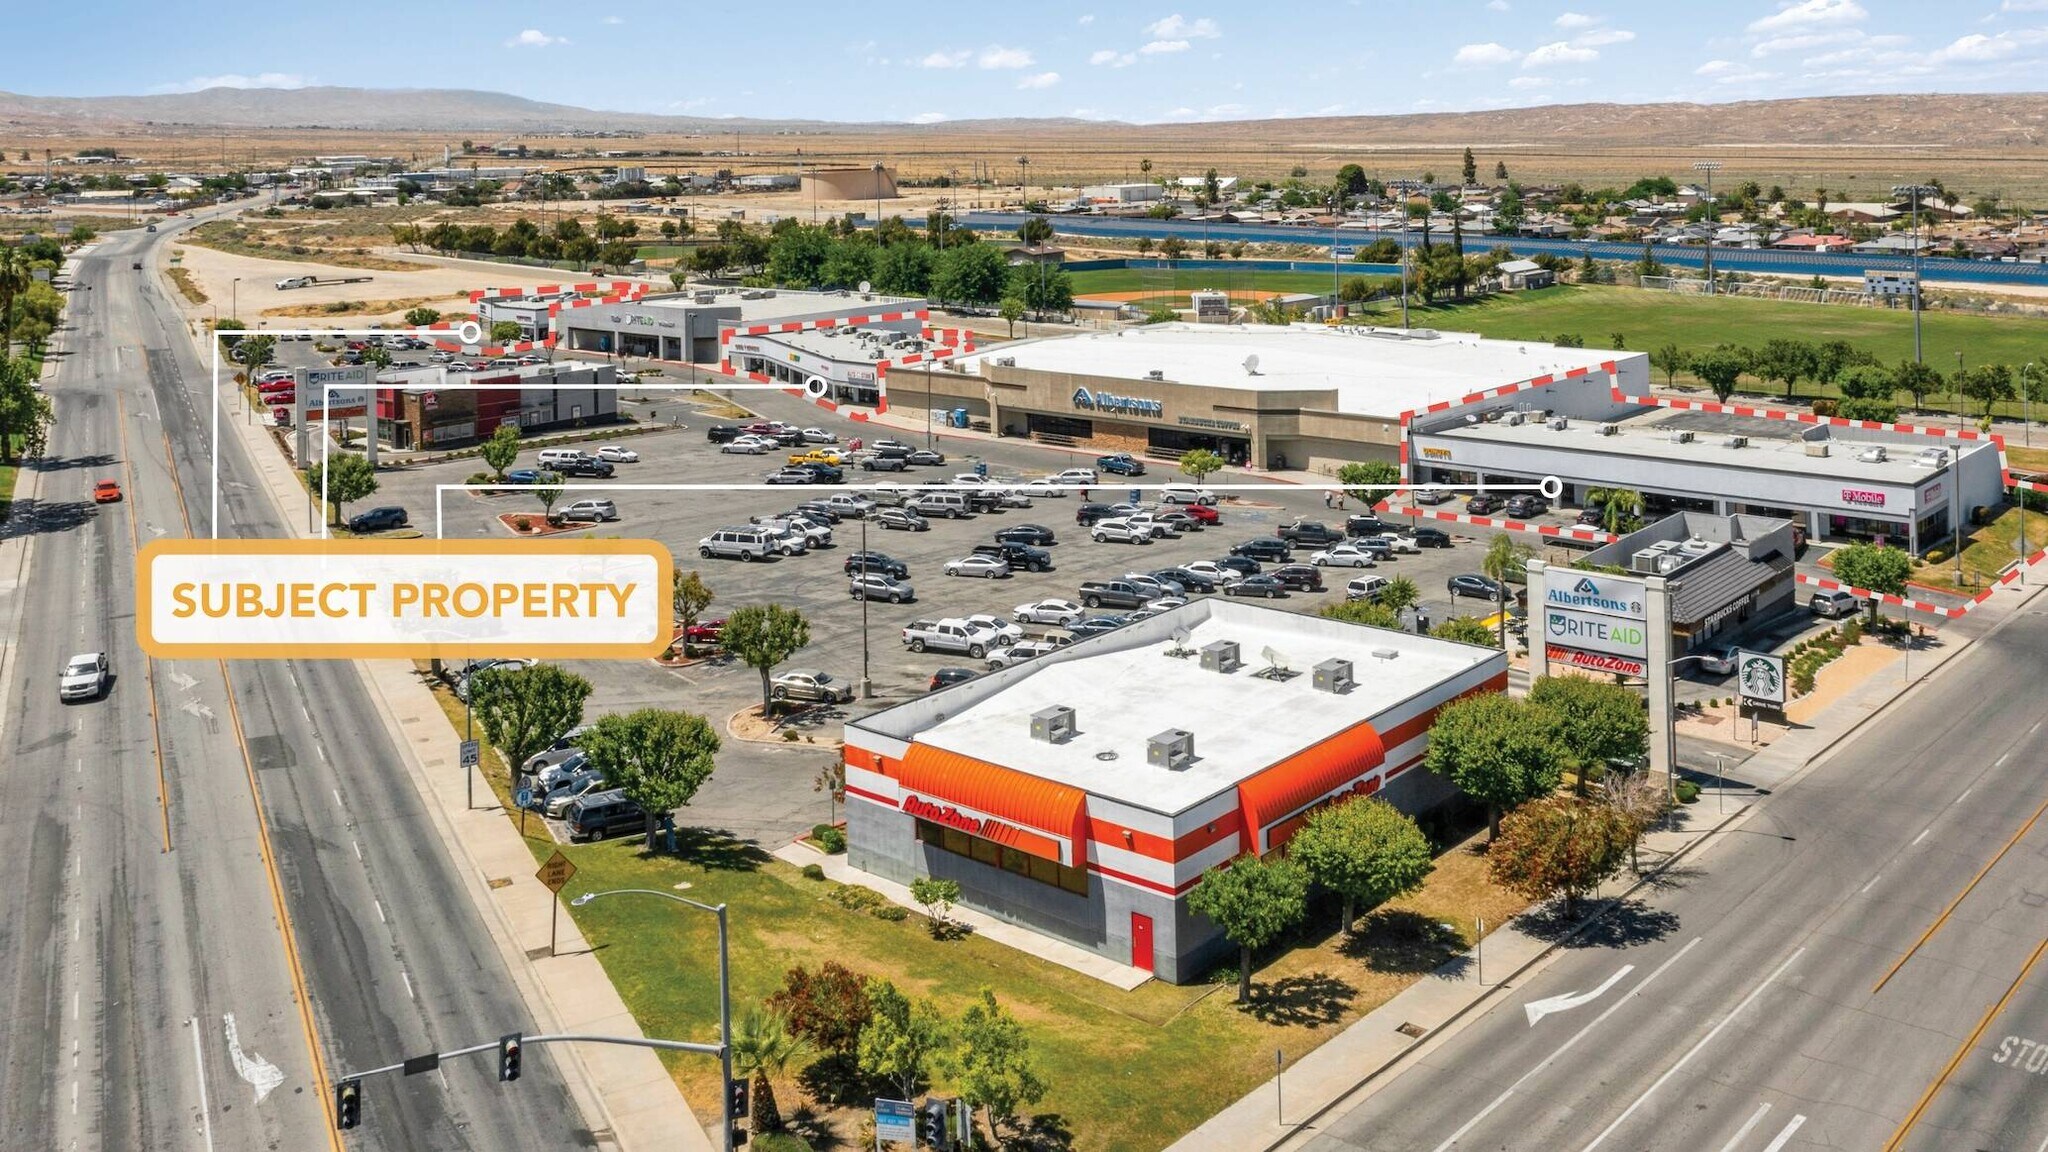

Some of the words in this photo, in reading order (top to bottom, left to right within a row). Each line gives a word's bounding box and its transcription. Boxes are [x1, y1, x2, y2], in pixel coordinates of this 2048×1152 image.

[320, 372, 345, 381] RITE
[345, 370, 364, 380] AID
[309, 397, 356, 407] Albrtsons
[1096, 391, 1163, 411] Albertsons
[1548, 589, 1627, 612] Albertsons
[1704, 604, 1734, 627] STARBUCKS
[1732, 594, 1751, 611] COFFEE
[1568, 618, 1608, 640] RITE
[1610, 627, 1642, 646] AID
[1572, 651, 1642, 675] AutoZone
[462, 754, 477, 764] 45
[902, 795, 981, 834] AutoZone
[547, 876, 565, 885] ENDS
[548, 868, 565, 877] LANE
[1992, 1035, 2048, 1075] STO
